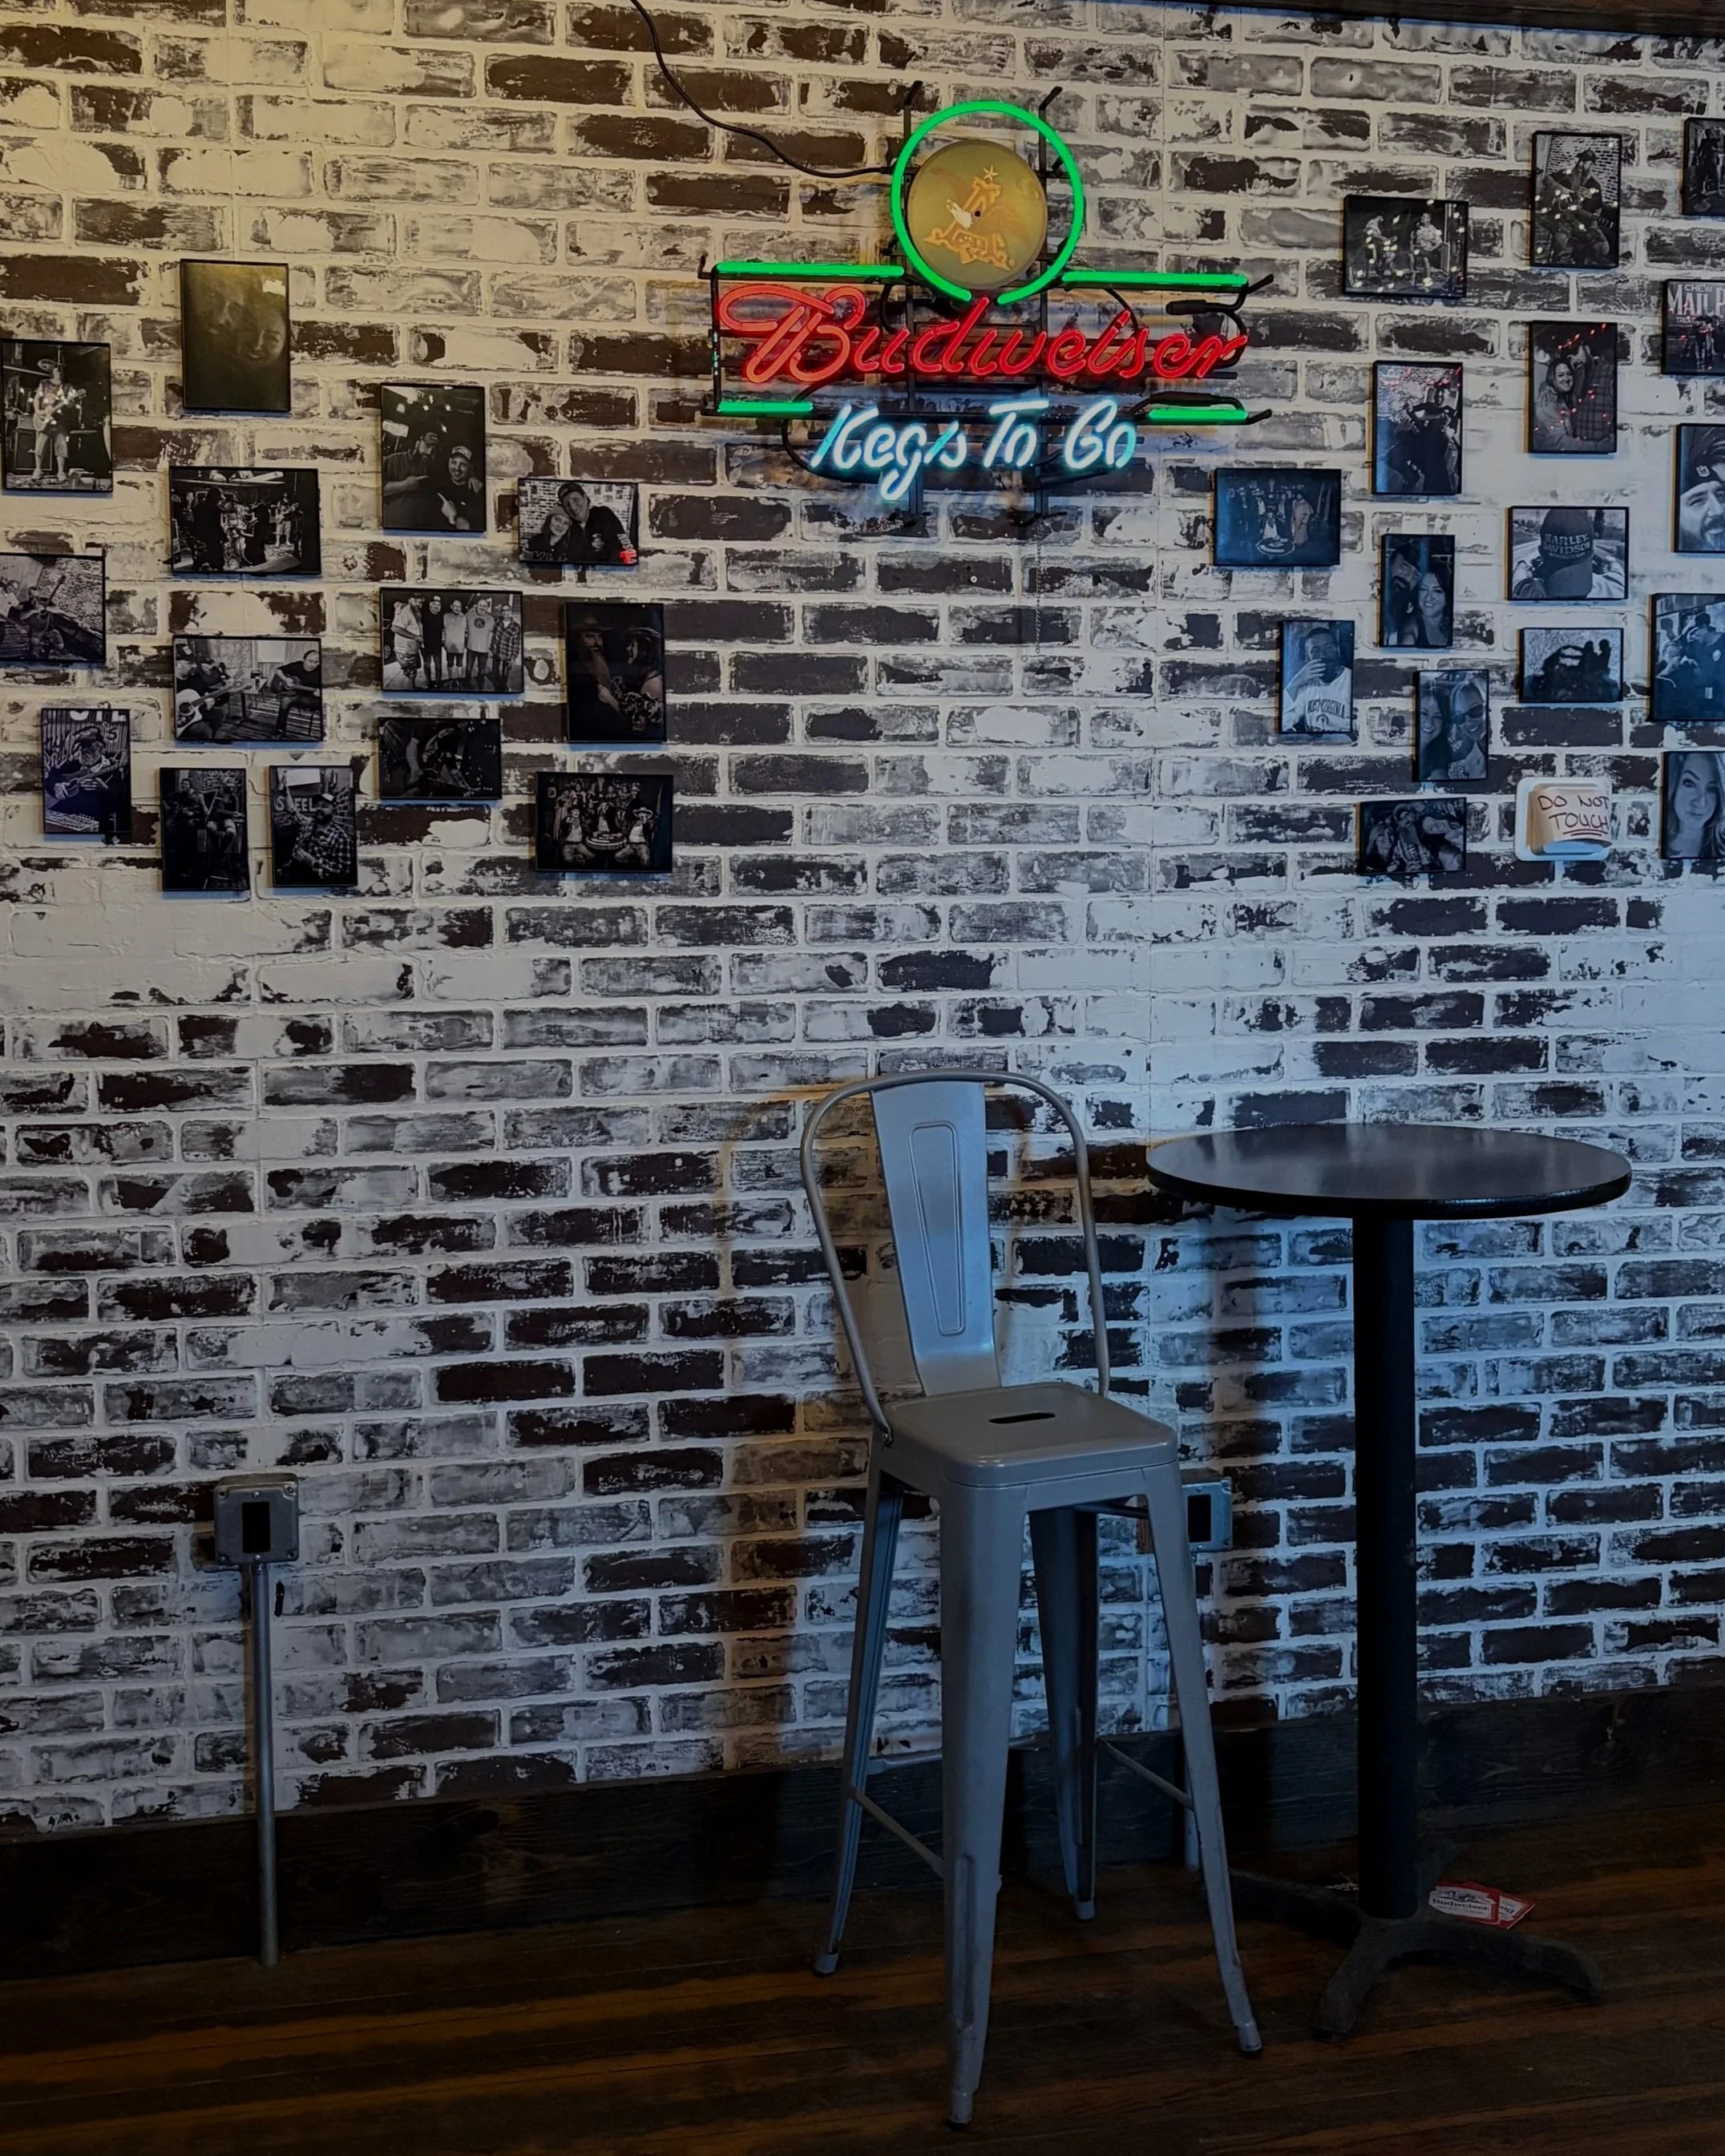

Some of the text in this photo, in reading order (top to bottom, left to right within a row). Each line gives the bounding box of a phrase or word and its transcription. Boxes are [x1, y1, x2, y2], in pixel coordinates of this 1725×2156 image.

[1684, 284, 1712, 293] CHEW
[1667, 285, 1714, 316] MAIL
[719, 285, 1247, 383] Budweiser
[812, 399, 1137, 501] Kegs To Go
[273, 795, 317, 812] SEEL
[1537, 794, 1610, 810] DO NOT
[1548, 812, 1609, 830] TOUCH
